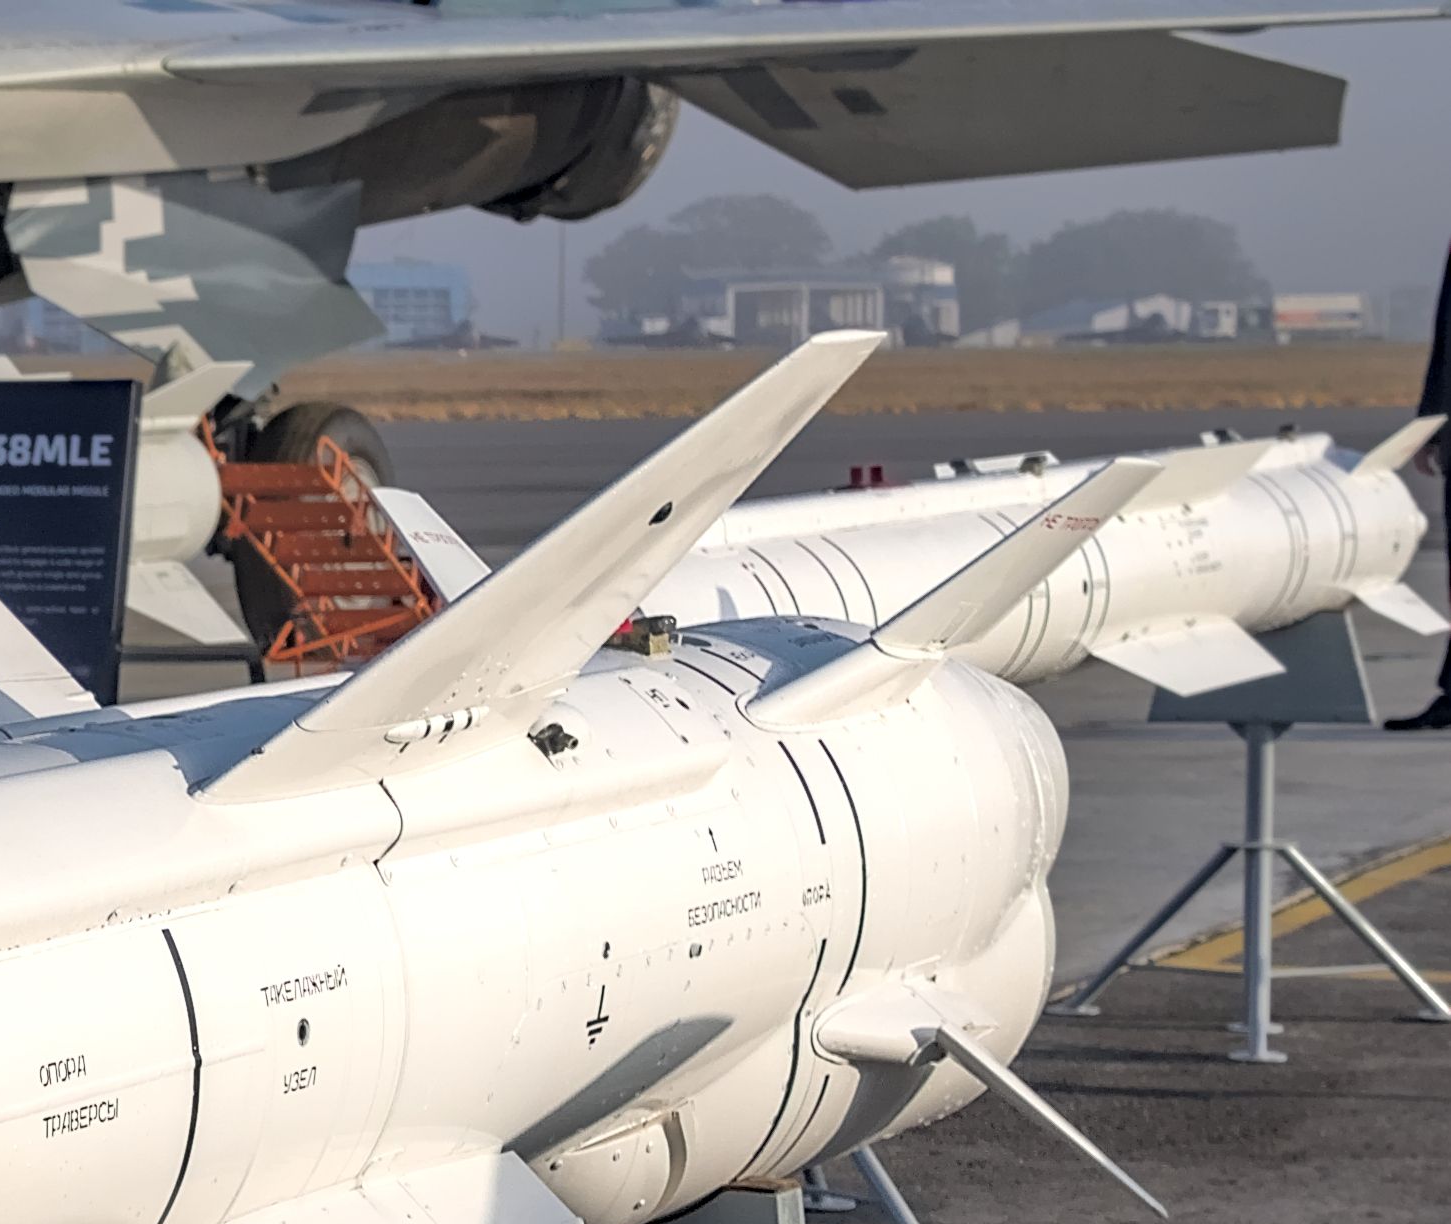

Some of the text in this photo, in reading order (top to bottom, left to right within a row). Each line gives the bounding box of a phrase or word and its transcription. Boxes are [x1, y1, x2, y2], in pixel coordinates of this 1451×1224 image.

[688, 891, 761, 928] БЕЗОПАСНОСТИ
[802, 877, 831, 907] ОПОРА
[260, 964, 347, 1007] ТАКЕЛАЖНЫЙ
[40, 1054, 86, 1087] ОПОРА
[283, 1066, 317, 1094] УЗЕЛ
[43, 1098, 119, 1139] ТРАВЕРСЫ
